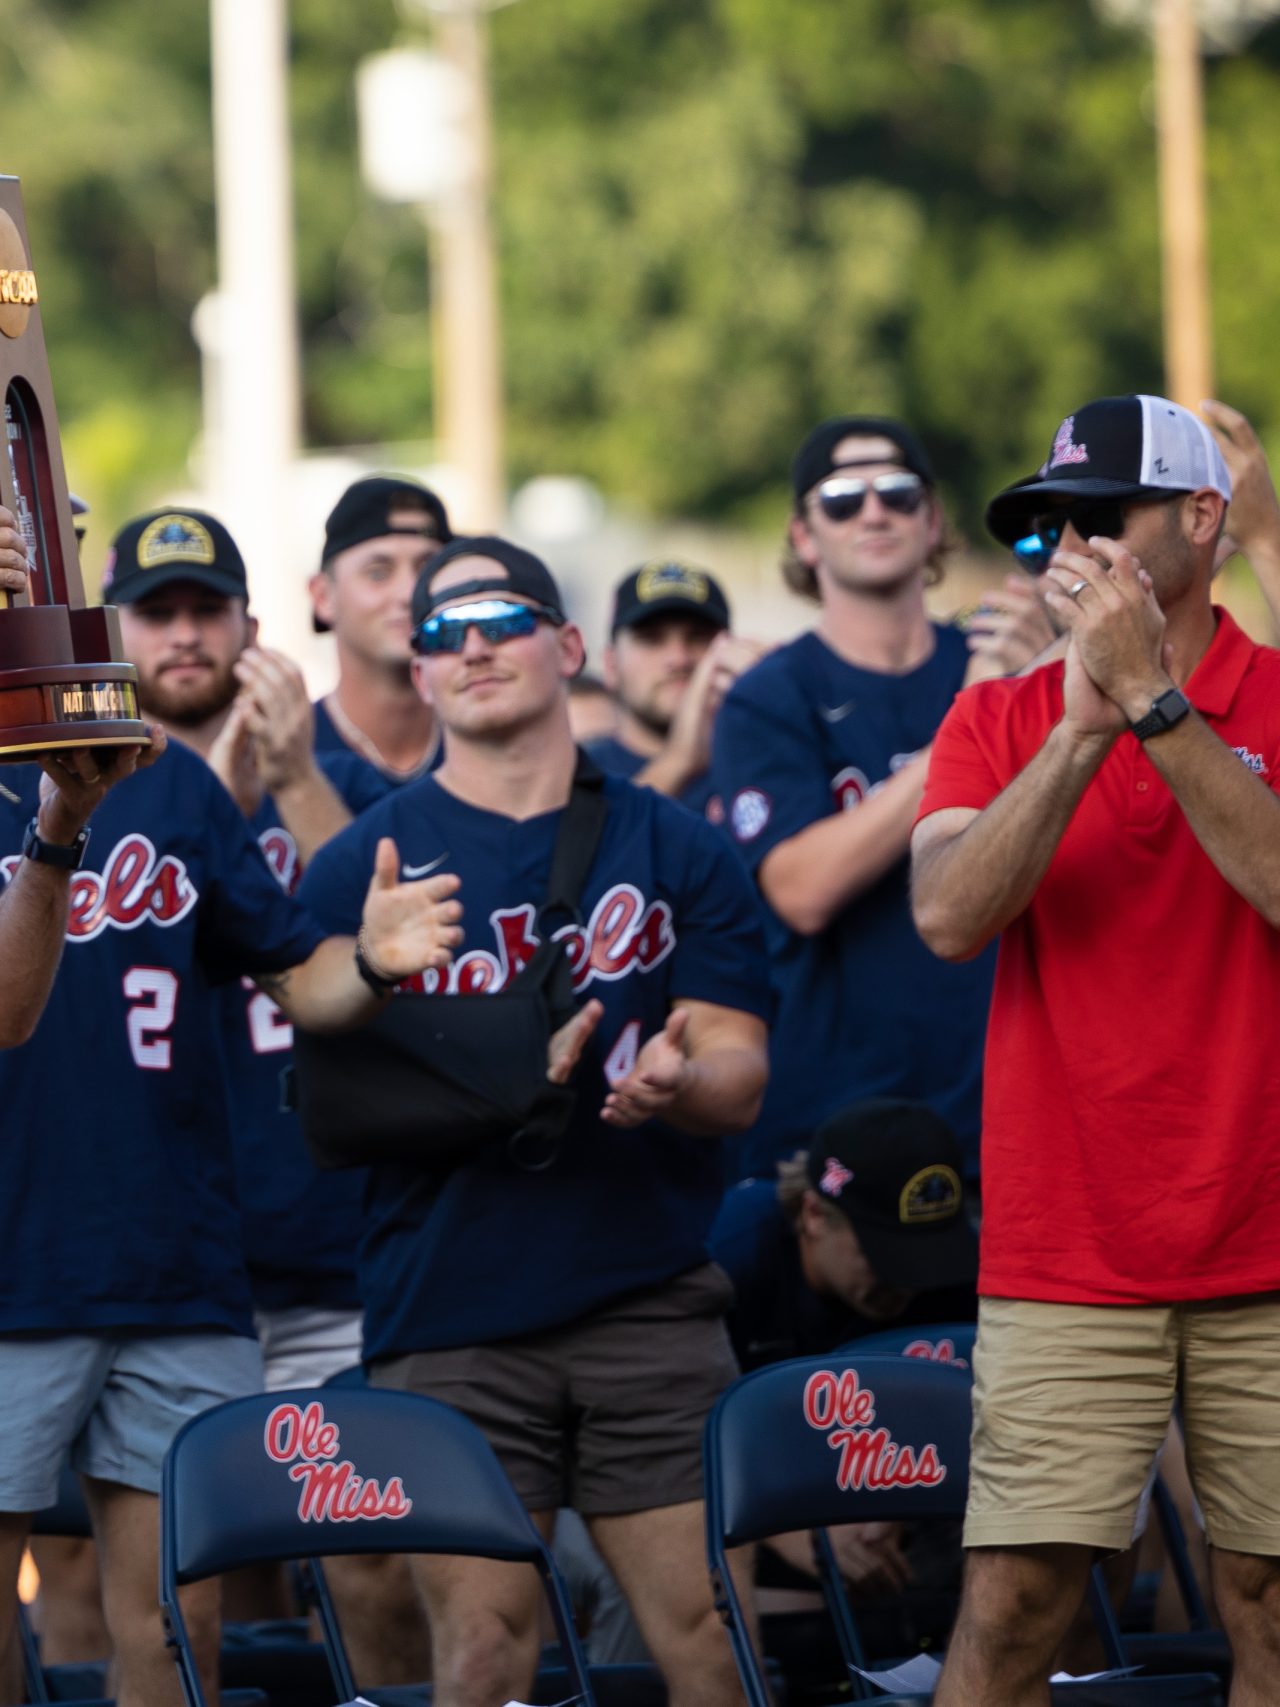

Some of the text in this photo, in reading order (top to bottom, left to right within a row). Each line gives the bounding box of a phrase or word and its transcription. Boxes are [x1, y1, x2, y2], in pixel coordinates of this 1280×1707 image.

[123, 965, 179, 1070] 2
[803, 1368, 875, 1430] Ole
[264, 1401, 340, 1463] Ole
[827, 1427, 947, 1492] Miss
[288, 1460, 413, 1524] Miss
